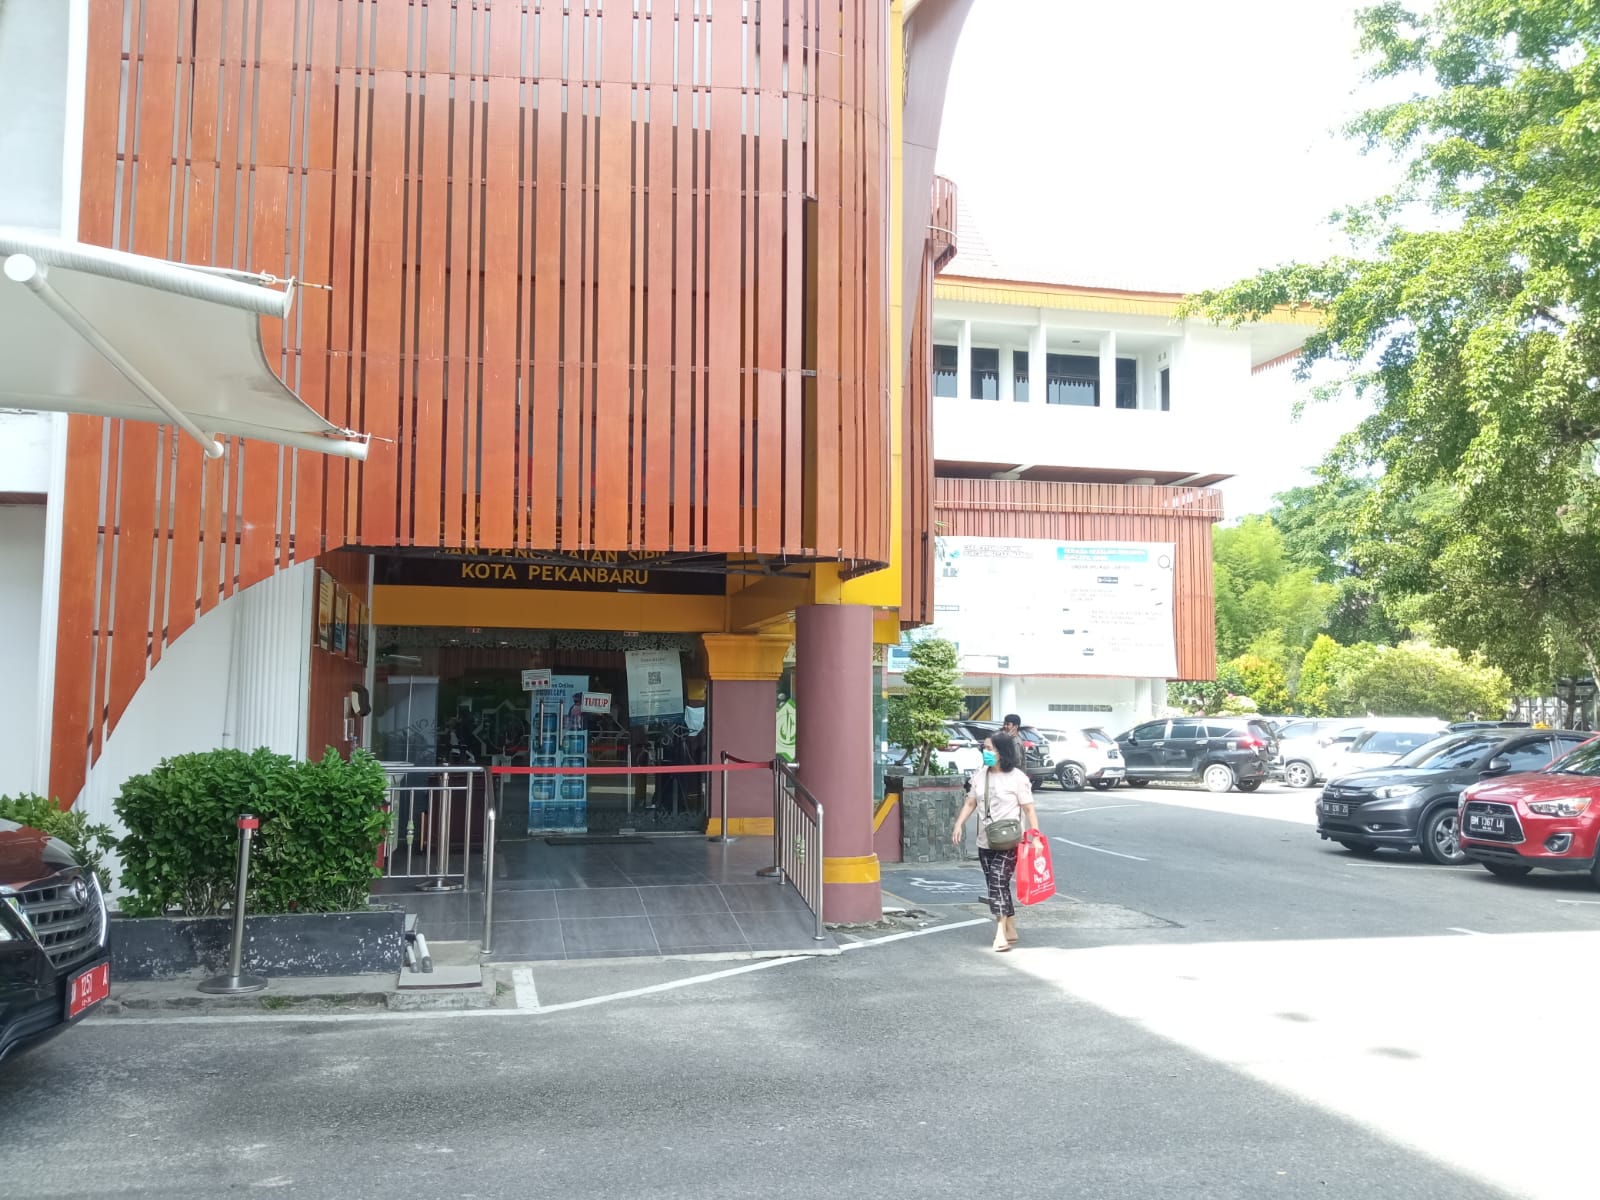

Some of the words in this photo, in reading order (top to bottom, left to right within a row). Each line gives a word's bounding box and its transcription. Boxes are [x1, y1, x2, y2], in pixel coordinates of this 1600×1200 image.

[461, 563, 517, 580] KOTA
[528, 565, 649, 585] PEKANBARU
[585, 697, 609, 708] TUTUP
[102, 965, 107, 986] A
